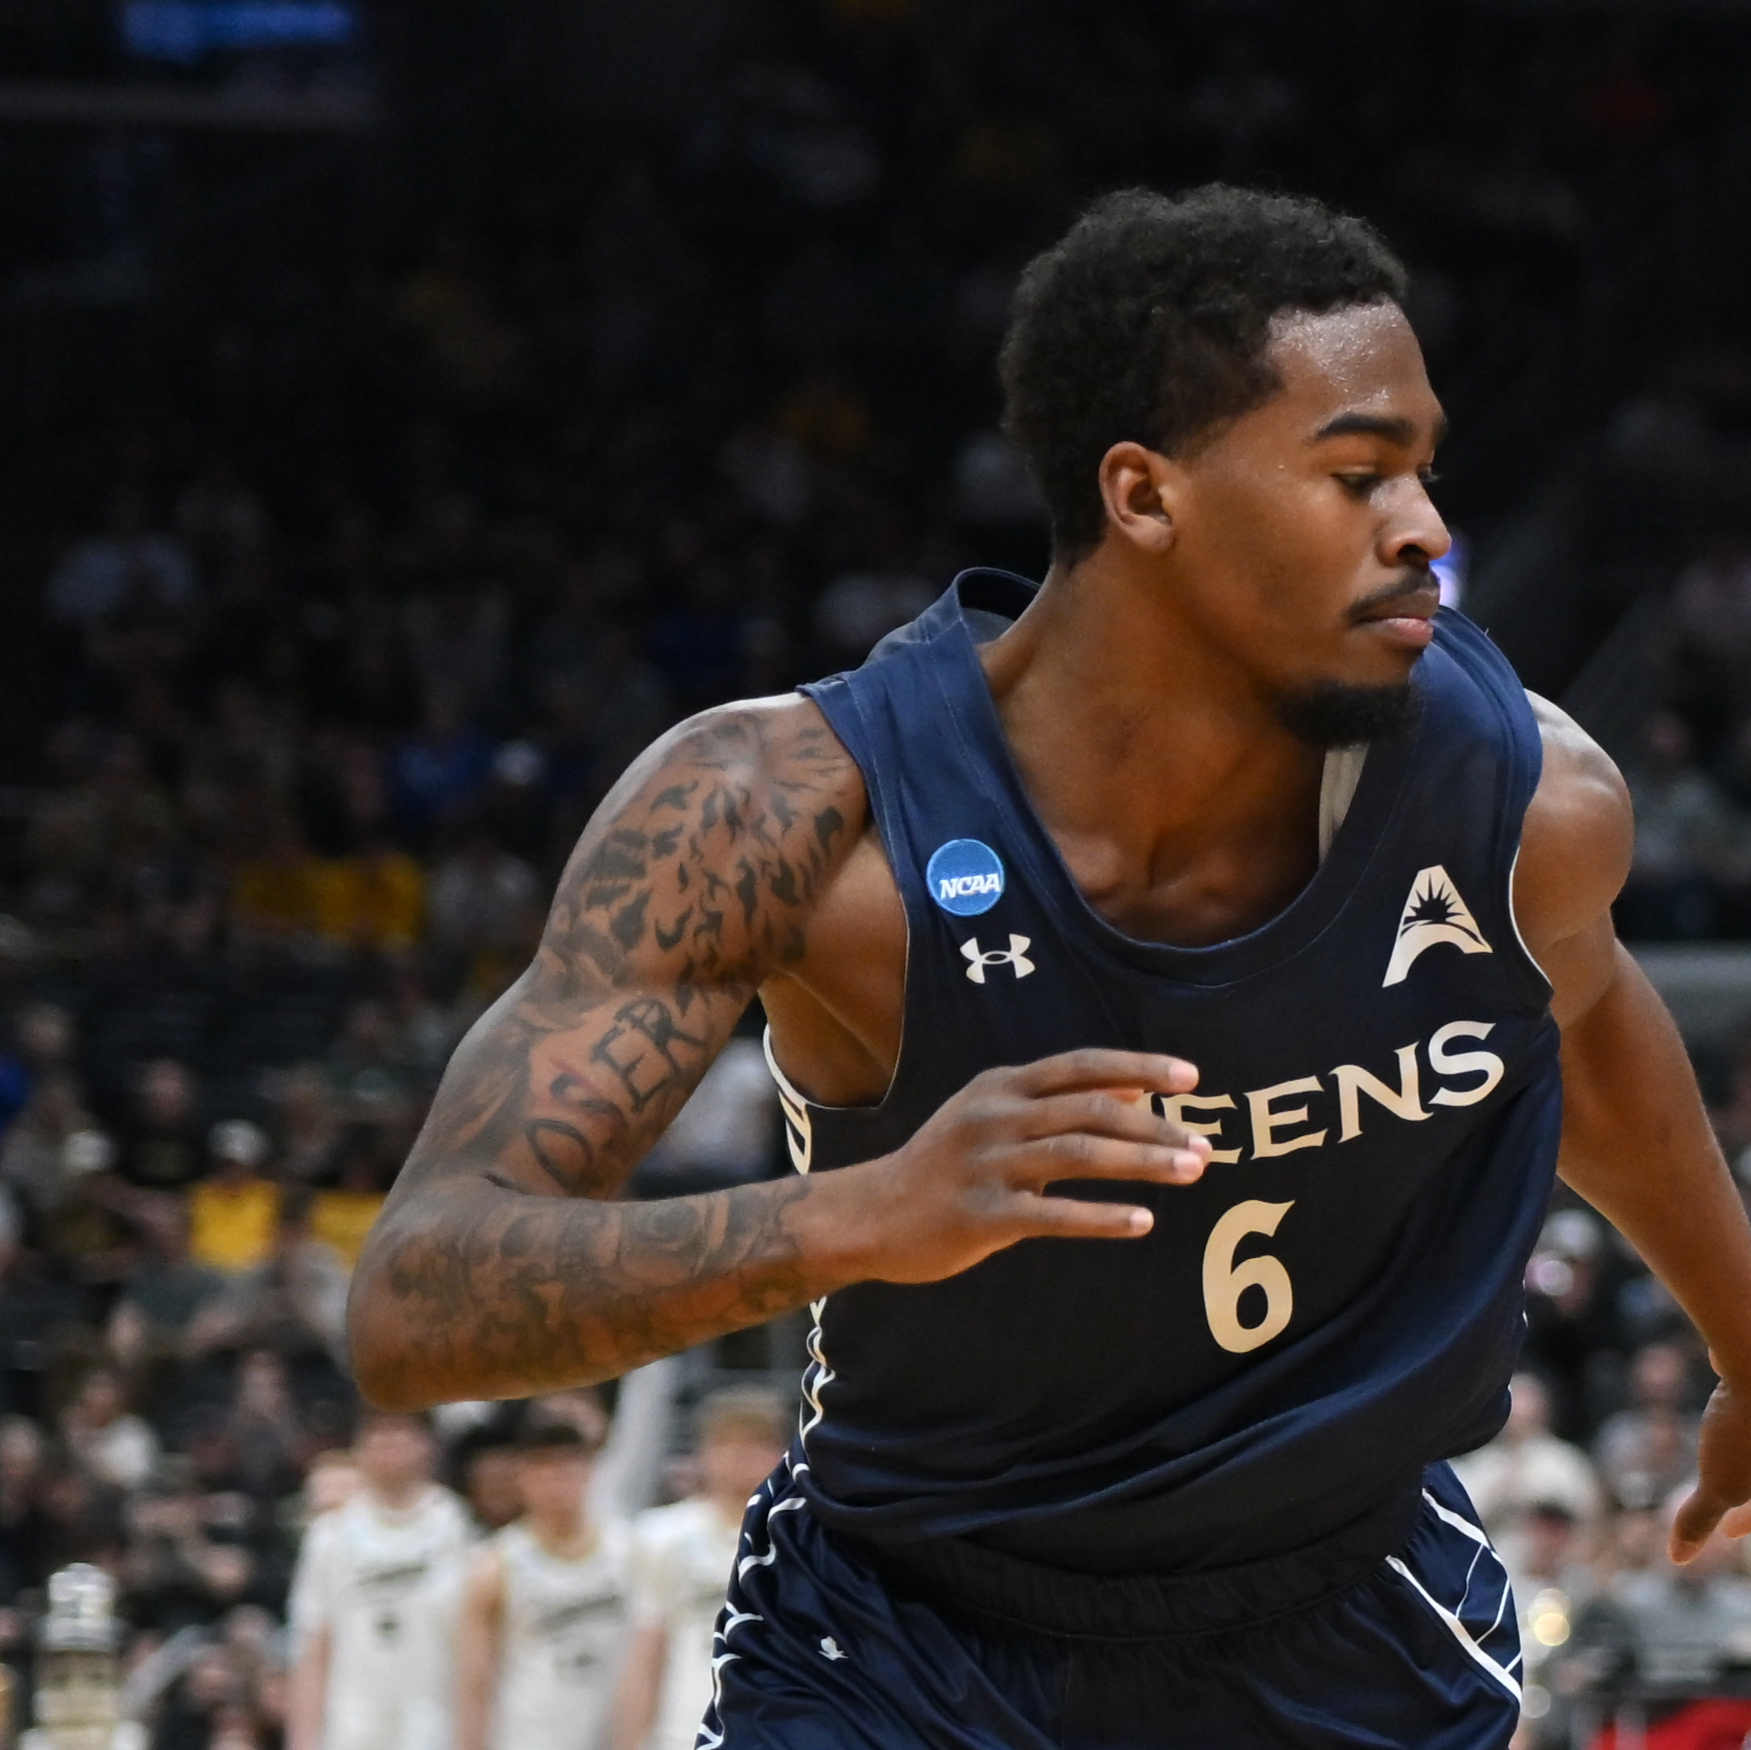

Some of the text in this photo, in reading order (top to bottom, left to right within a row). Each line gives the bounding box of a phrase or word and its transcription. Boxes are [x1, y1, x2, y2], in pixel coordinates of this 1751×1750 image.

[938, 871, 1002, 900] NCAA
[1136, 1019, 1506, 1165] EENS
[1201, 1199, 1296, 1354] 6
